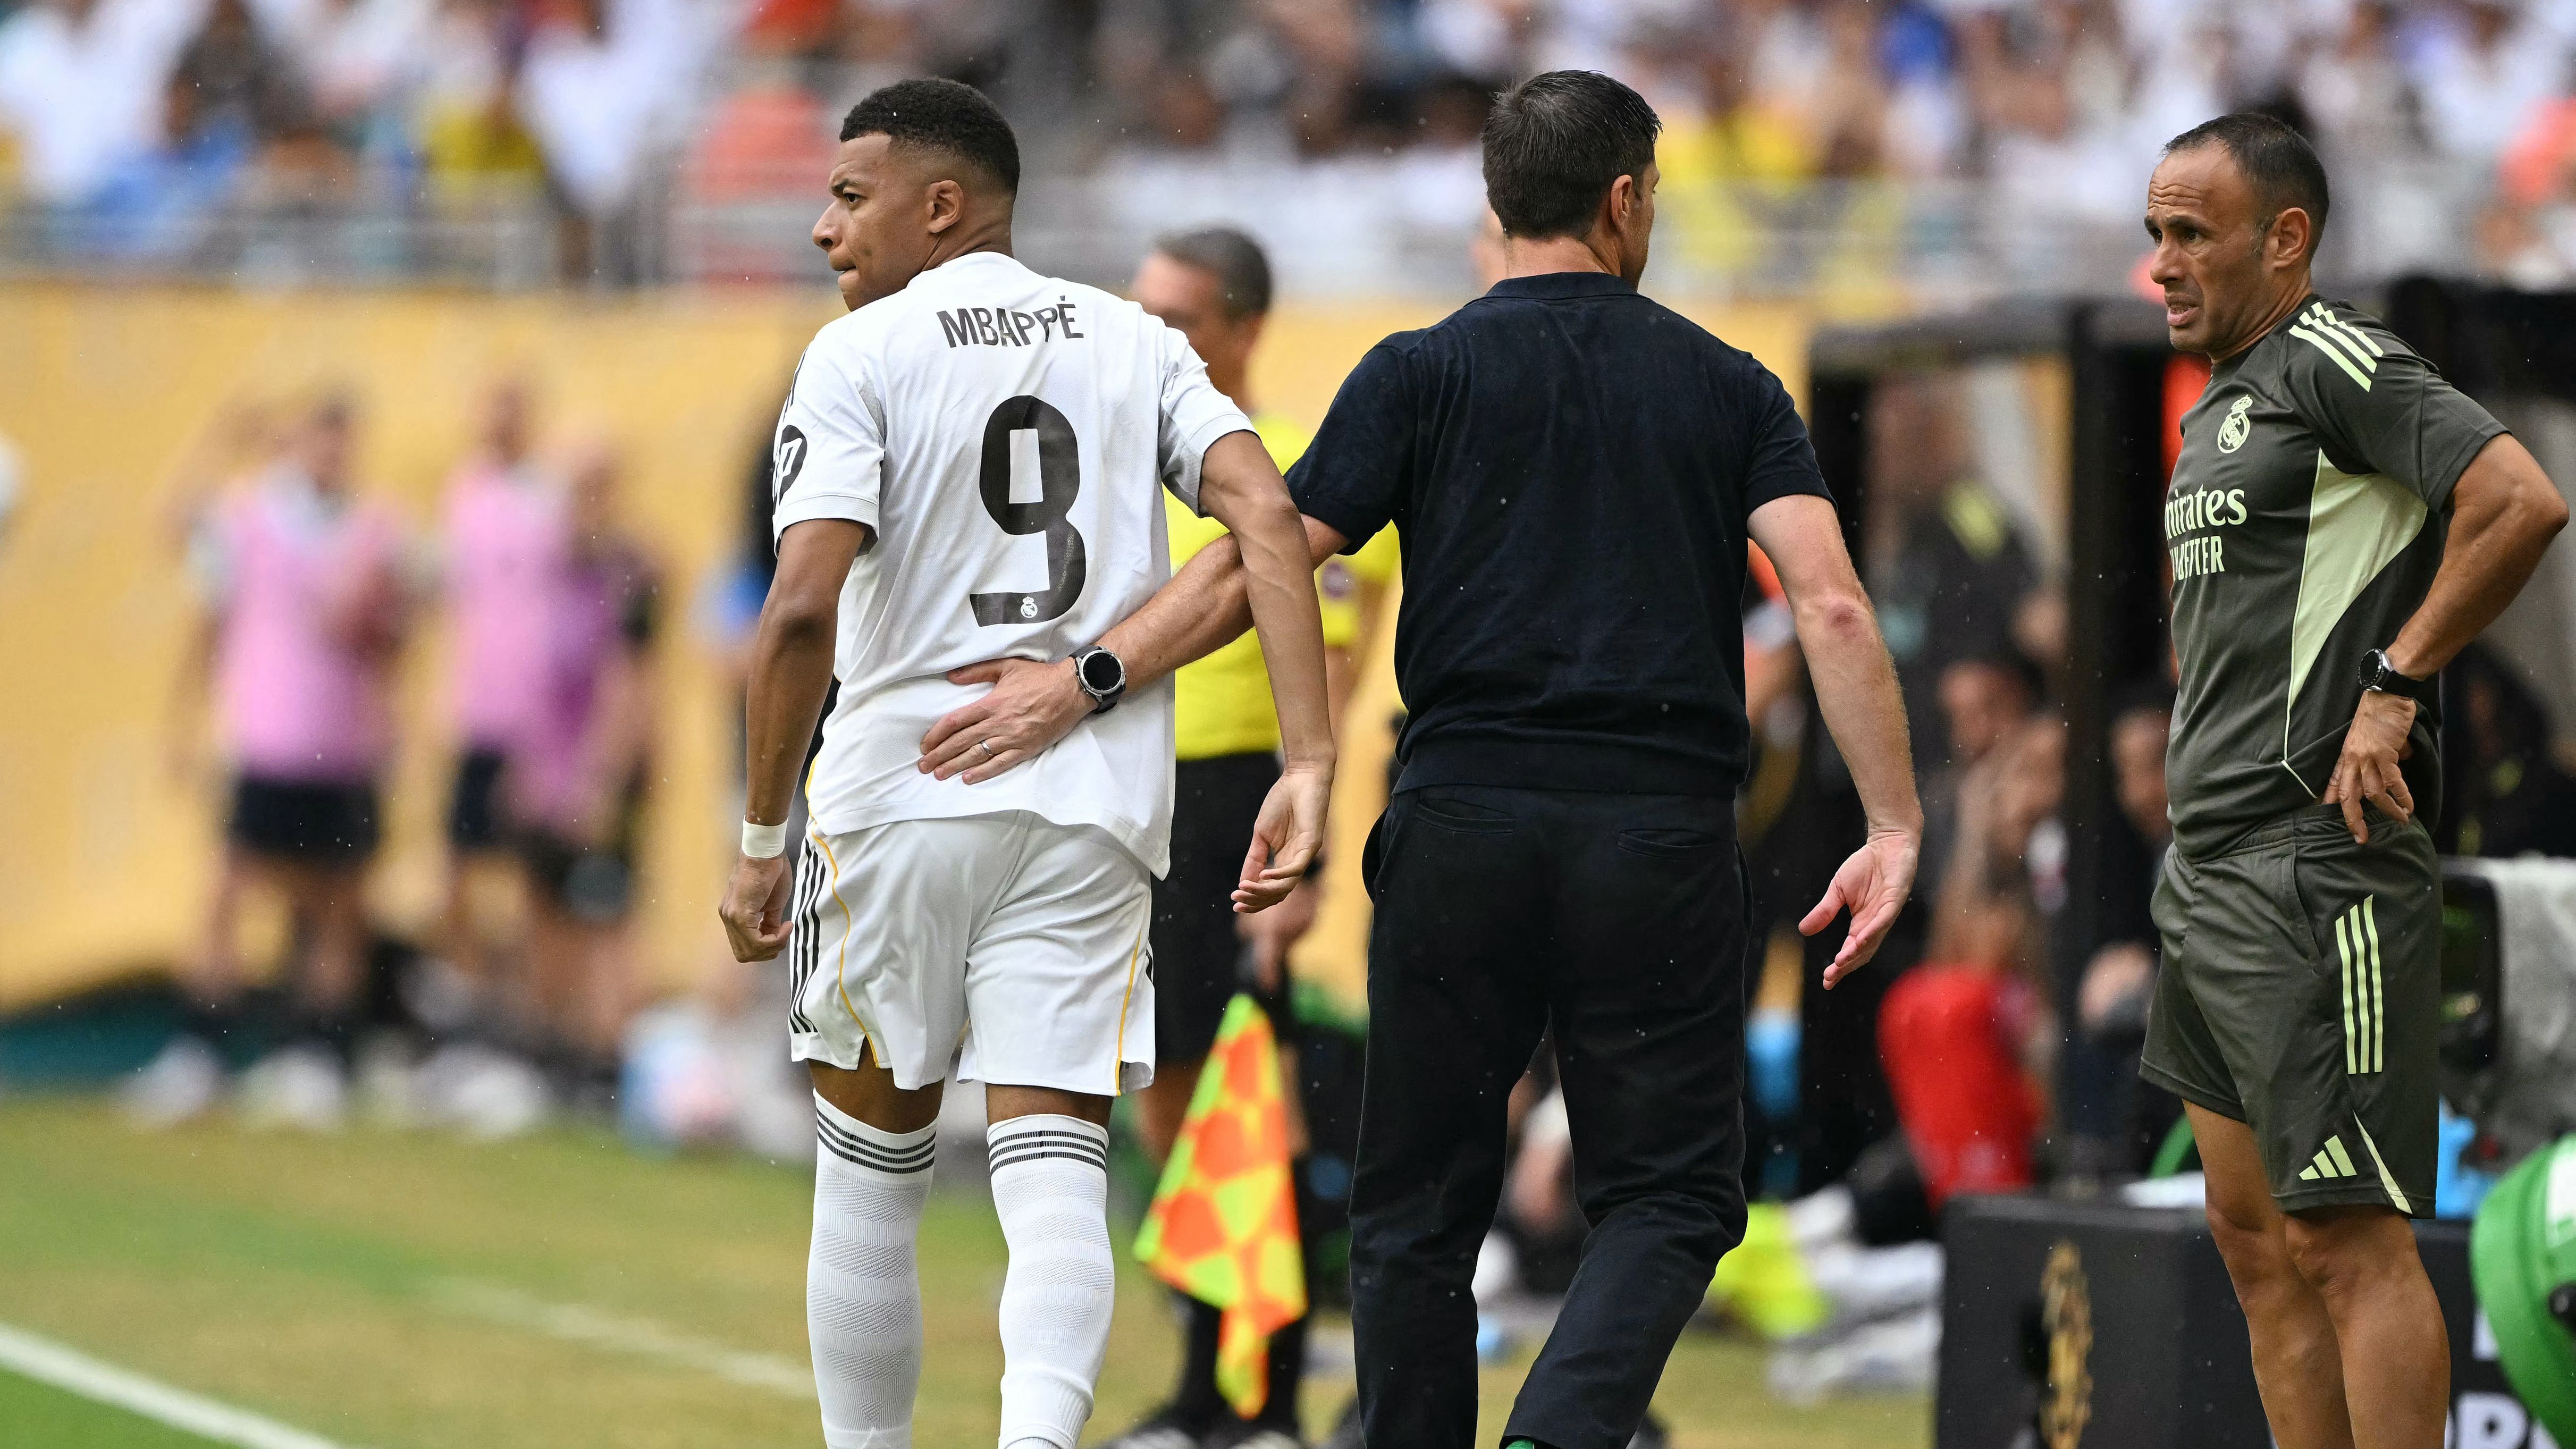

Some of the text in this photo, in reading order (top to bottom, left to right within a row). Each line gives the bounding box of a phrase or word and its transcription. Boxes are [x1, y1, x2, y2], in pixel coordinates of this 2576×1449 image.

[936, 296, 1084, 348] MBAPPÉ
[970, 395, 1086, 627] 9
[2165, 484, 2247, 540] mirates
